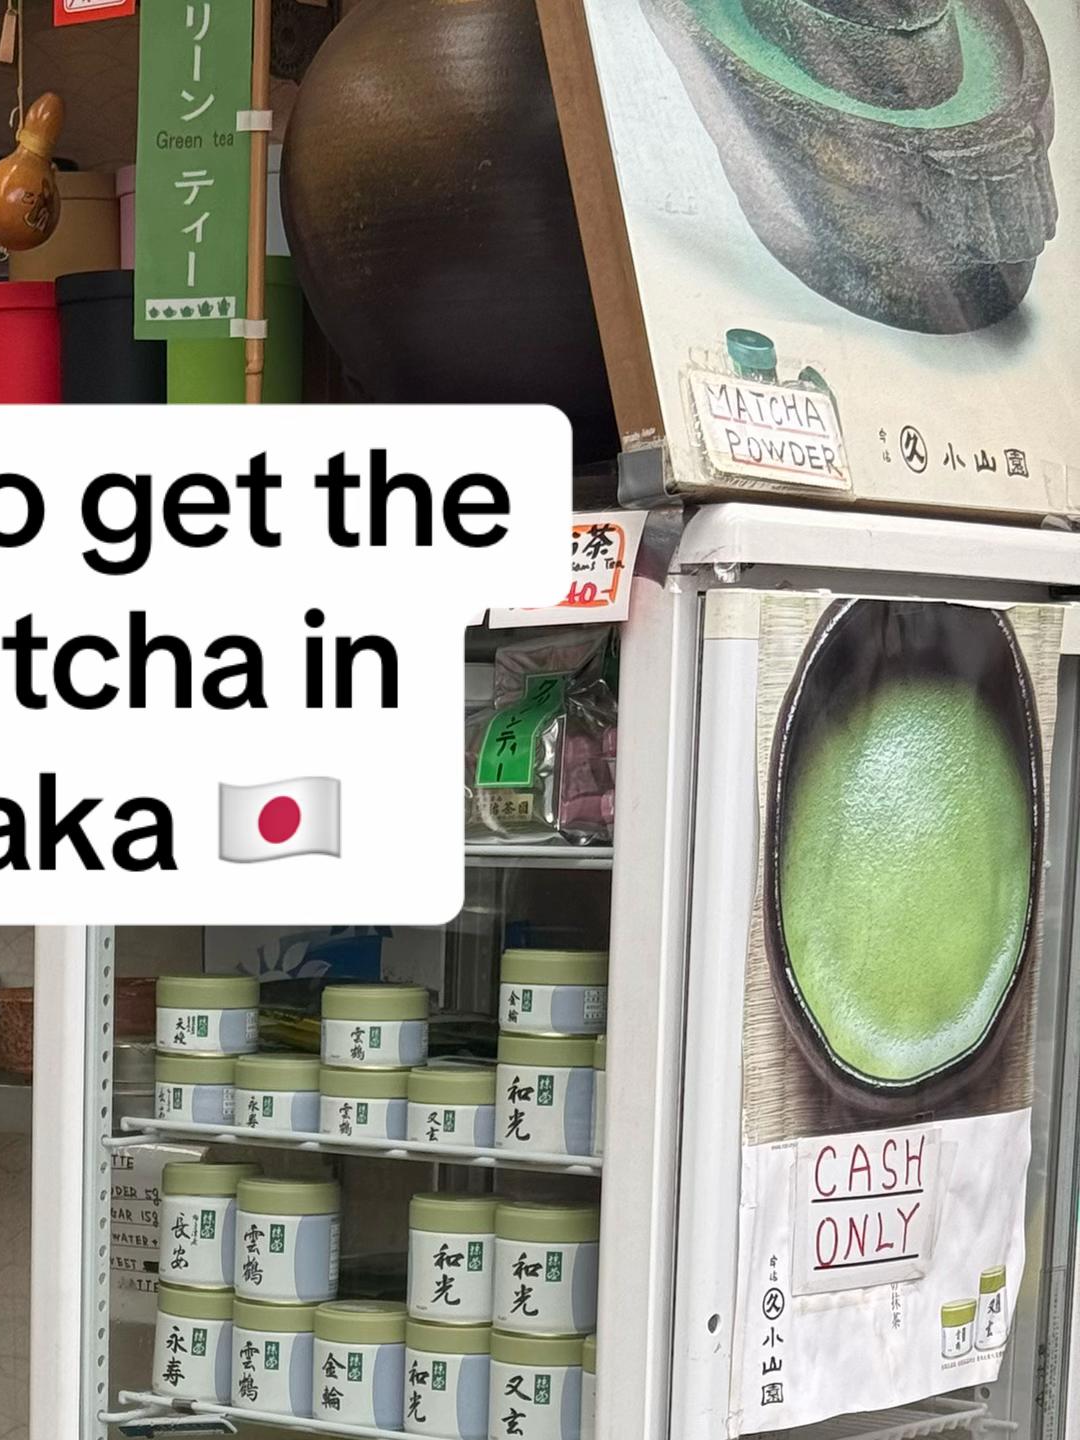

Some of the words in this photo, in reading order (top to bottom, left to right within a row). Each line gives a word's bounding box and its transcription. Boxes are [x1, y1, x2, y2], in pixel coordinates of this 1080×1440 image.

[156, 131, 203, 150] Green
[212, 131, 234, 148] tea
[707, 383, 826, 431] MATCHA
[725, 428, 843, 477] POWDER
[505, 1075, 535, 1142] 和光
[814, 1135, 925, 1197] CASH
[815, 1202, 921, 1269] ONLY
[431, 1243, 465, 1306] 和光
[510, 1252, 543, 1317] 和光
[321, 1352, 346, 1411] 金輪
[407, 1360, 430, 1422] 和光
[502, 1375, 532, 1436] 又玄
